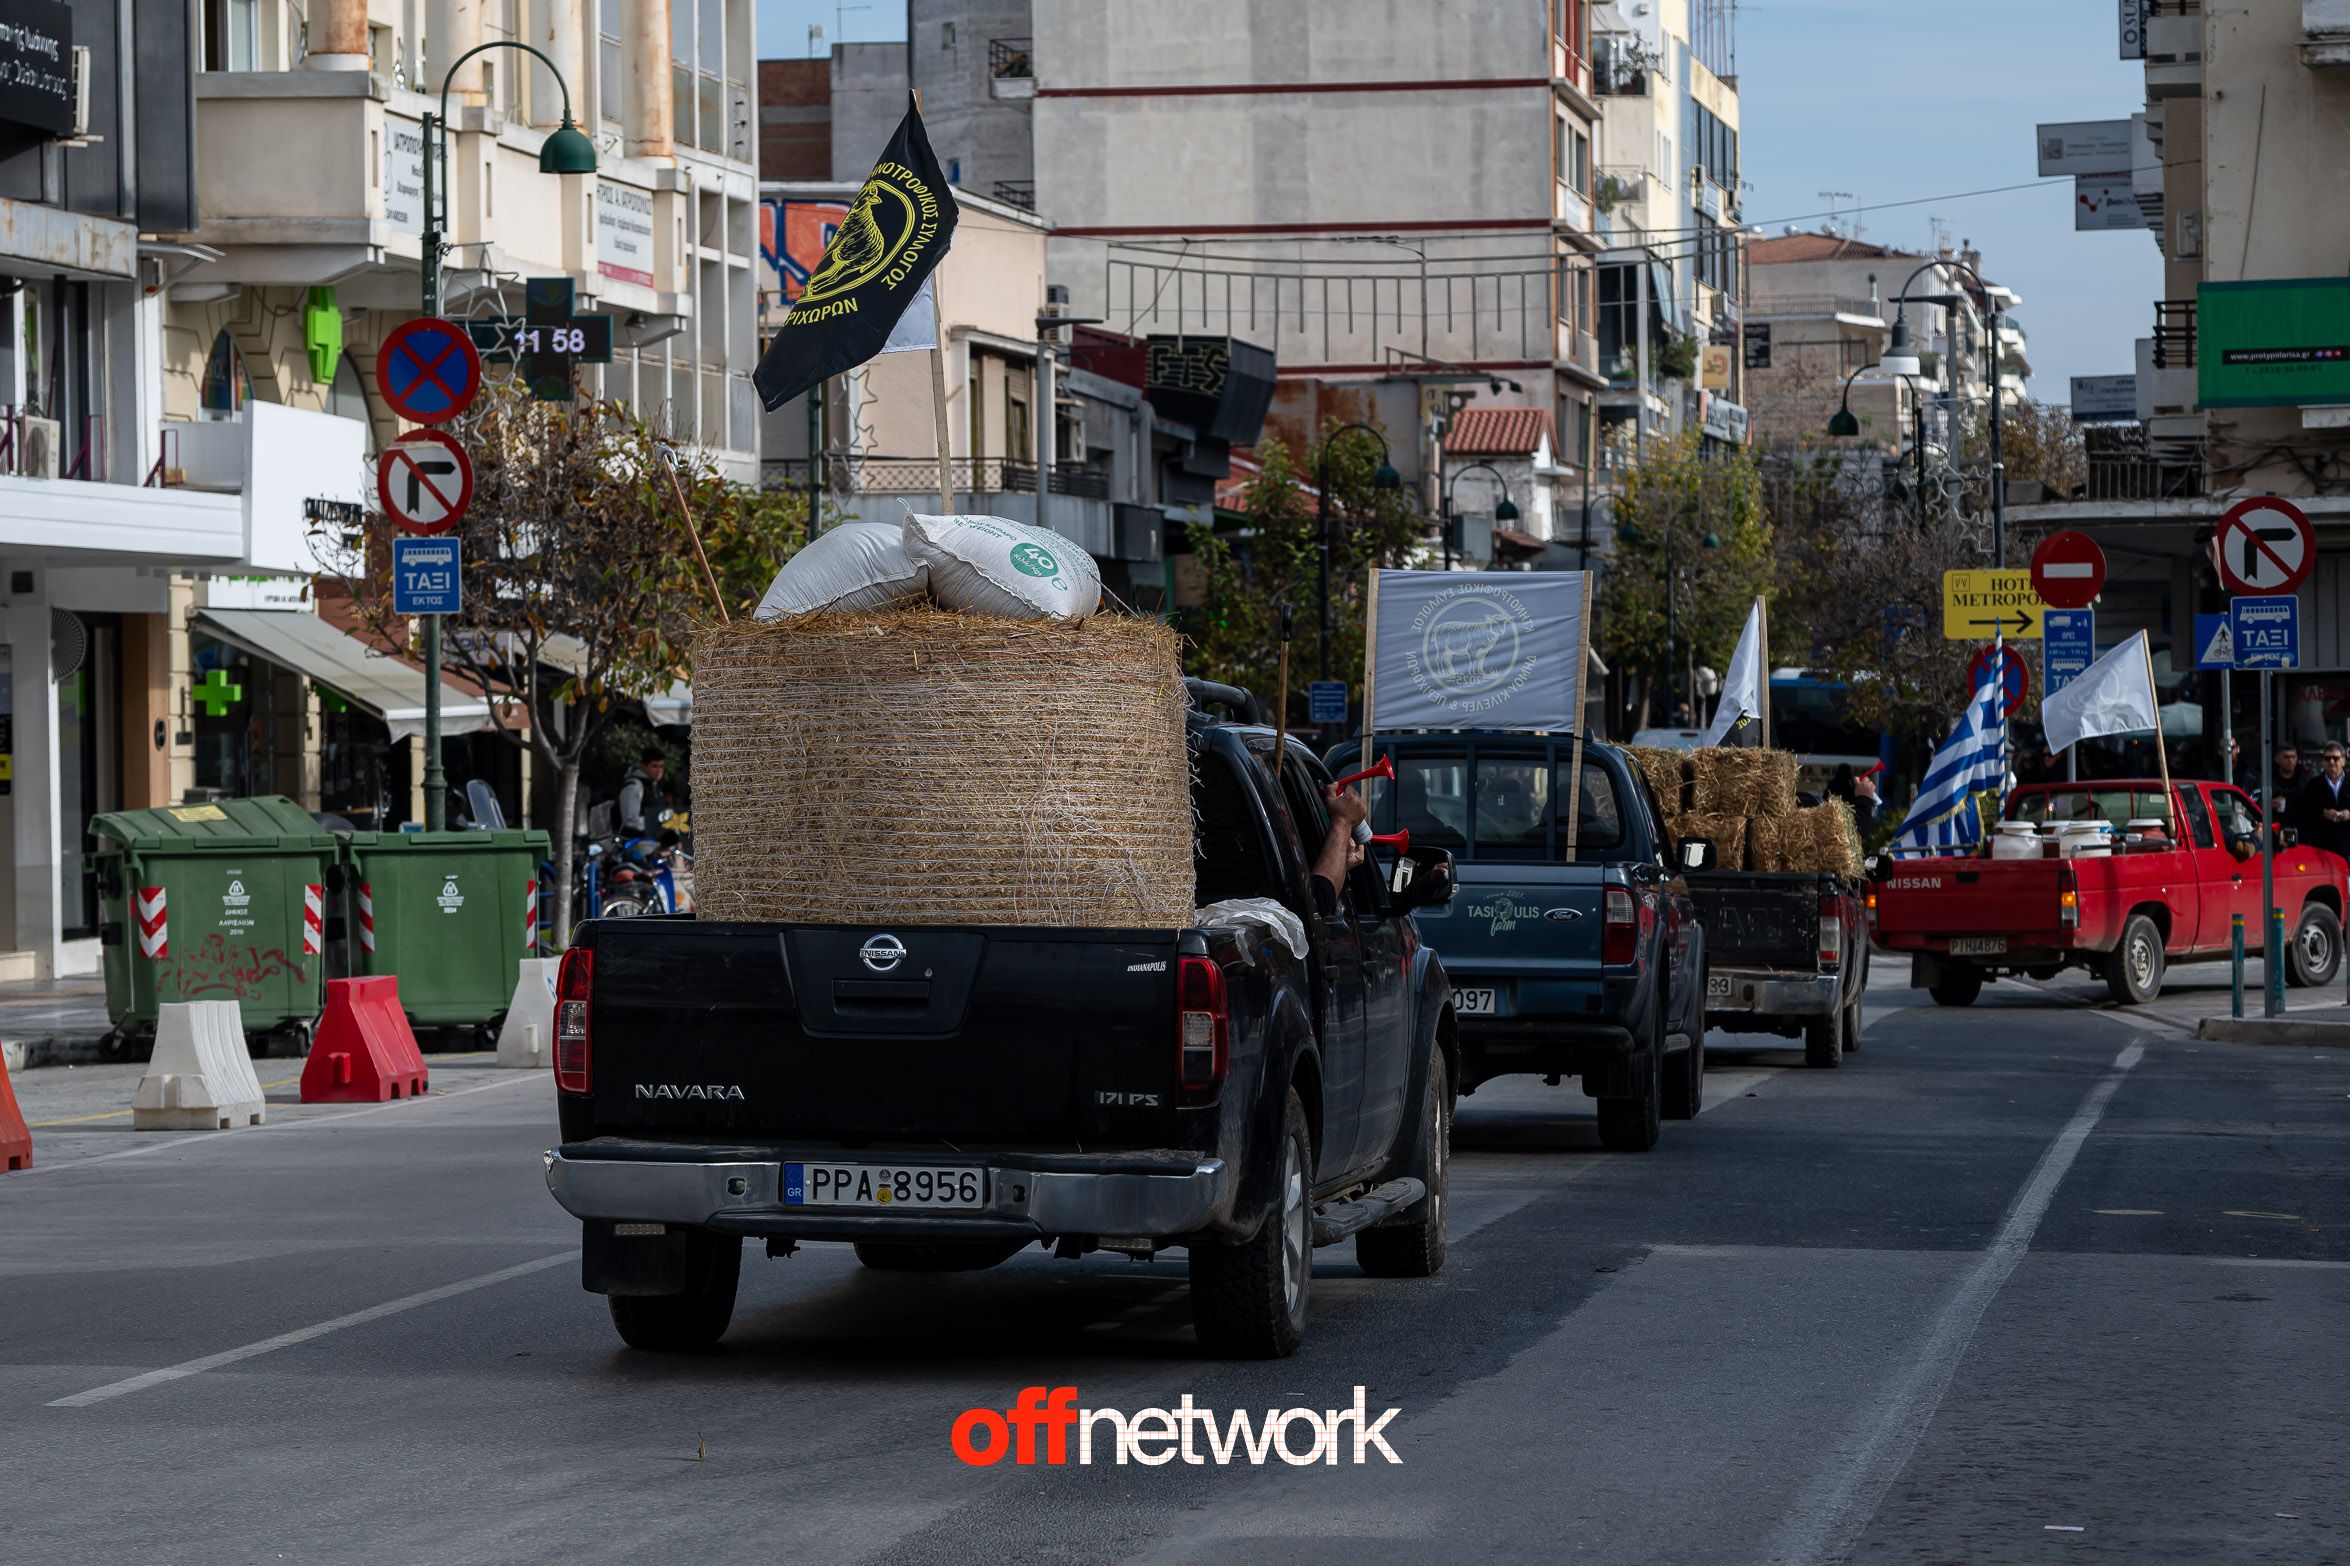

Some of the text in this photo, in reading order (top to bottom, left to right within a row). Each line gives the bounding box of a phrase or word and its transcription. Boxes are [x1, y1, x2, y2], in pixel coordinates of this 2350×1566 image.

[880, 223, 938, 290] ΣΥΛΛΟΓΟΣ
[552, 328, 585, 353] 58
[1024, 548, 1054, 570] 40
[404, 572, 450, 590] ΤΑΞΙ
[412, 595, 444, 606] ΕΚΤΟΣ
[2242, 629, 2289, 647] ΤΑΞΙ
[1887, 877, 1942, 889] NISSAN
[1490, 917, 1517, 937] farm
[1127, 960, 1167, 972] INDIANAPOLIS
[635, 1084, 745, 1100] NAVARA
[1129, 1093, 1159, 1107] PS
[787, 1187, 802, 1198] GR
